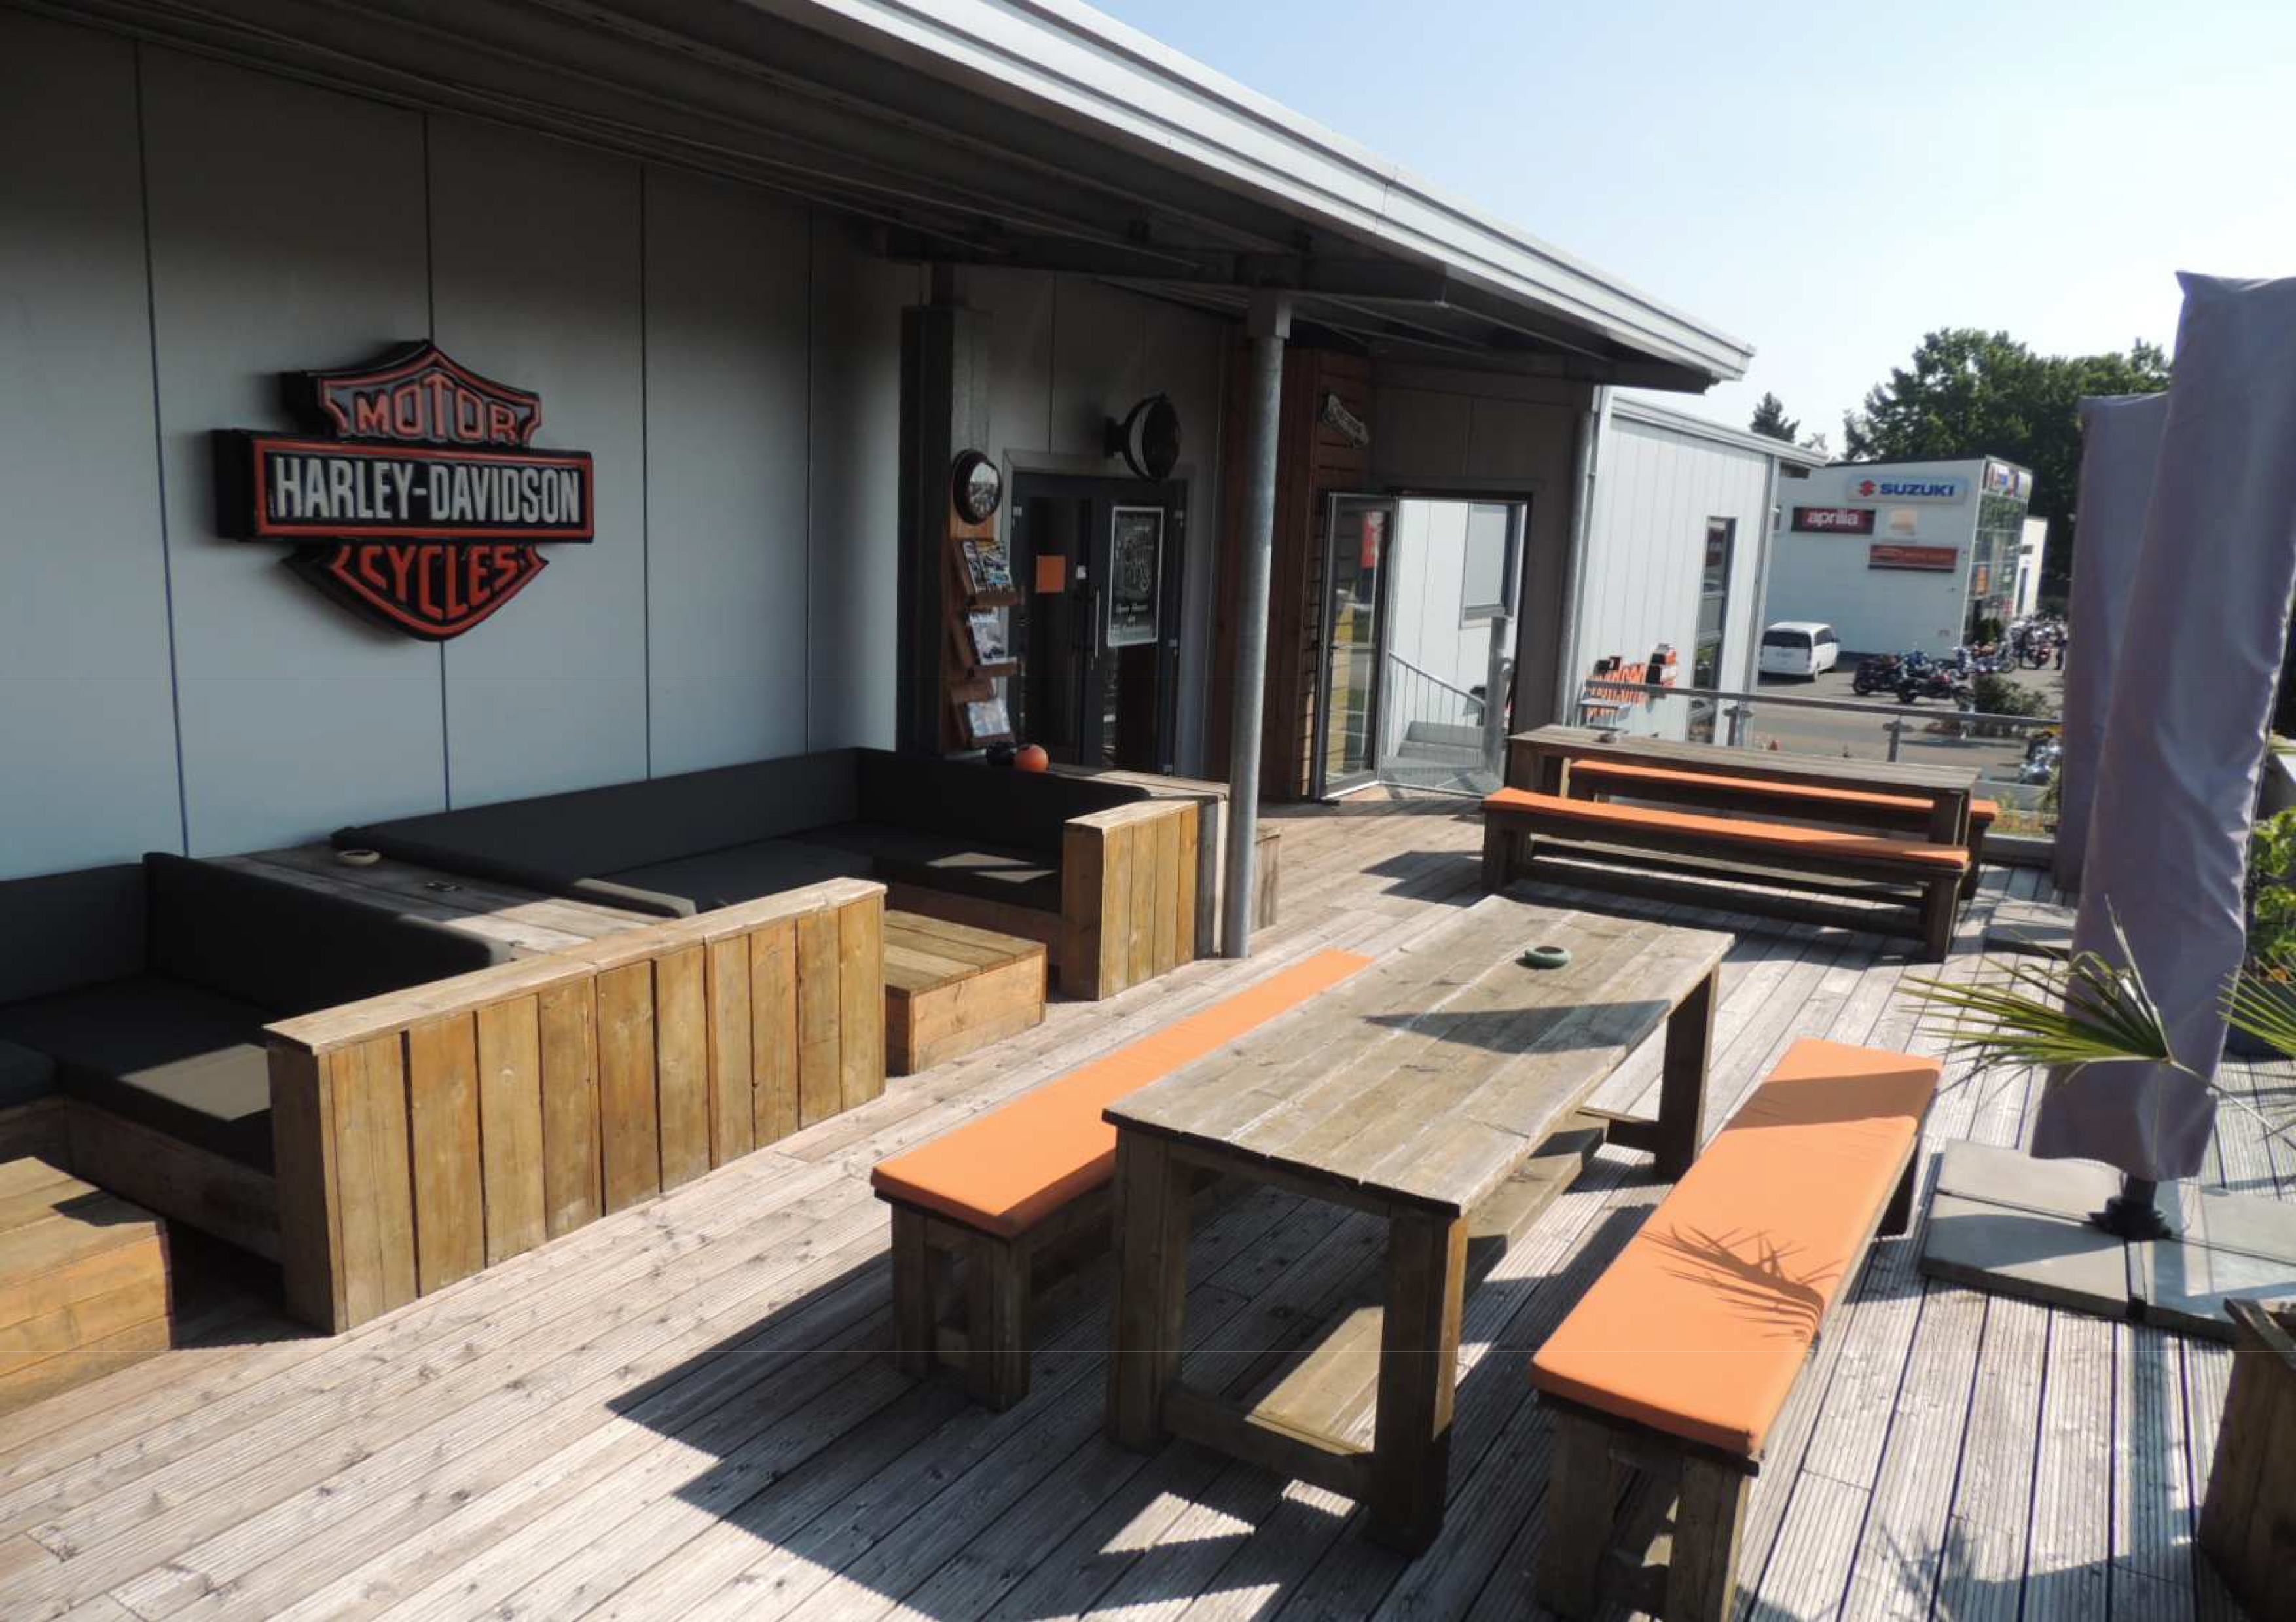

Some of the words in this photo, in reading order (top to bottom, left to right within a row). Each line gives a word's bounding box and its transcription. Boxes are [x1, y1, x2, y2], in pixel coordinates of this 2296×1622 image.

[356, 372, 518, 442] MOTOR
[273, 456, 581, 524] HARLEY-DAVIDSON
[1808, 507, 1858, 526] aprilia
[1880, 483, 1955, 496] SUZUKI
[359, 545, 519, 619] CYCLES
